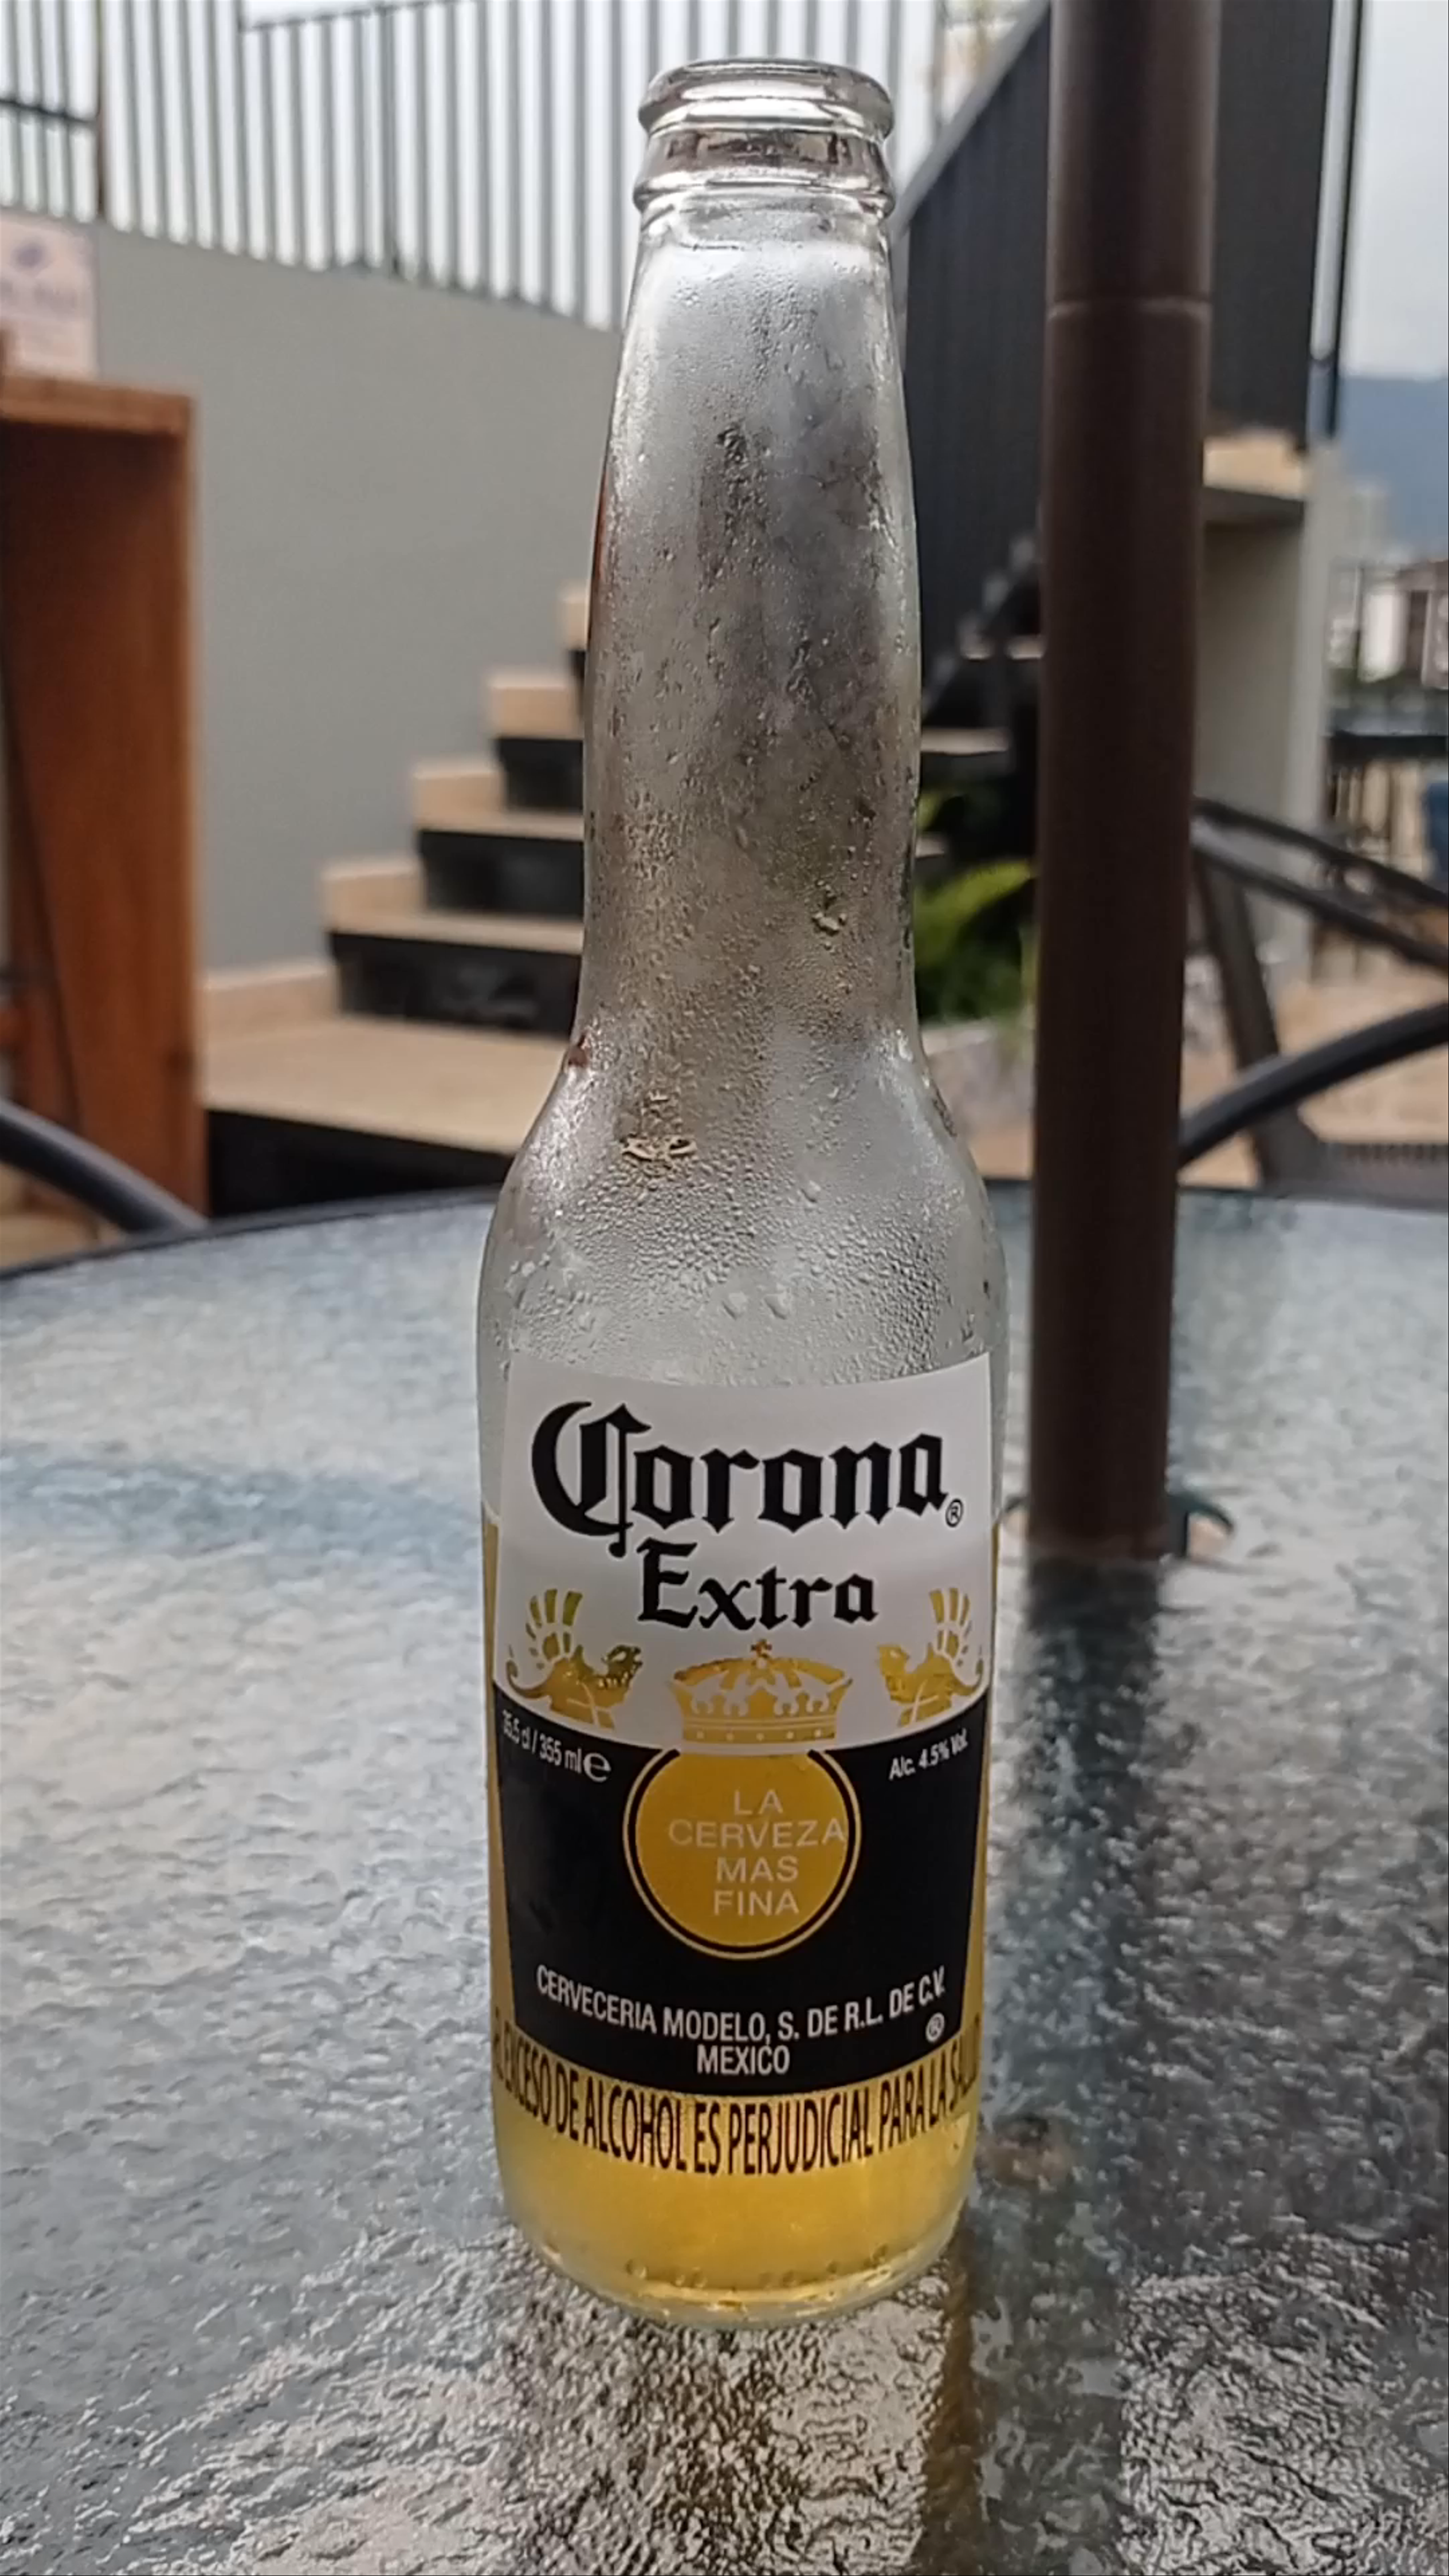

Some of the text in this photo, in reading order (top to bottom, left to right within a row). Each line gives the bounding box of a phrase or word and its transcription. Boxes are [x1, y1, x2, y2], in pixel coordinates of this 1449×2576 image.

[531, 1401, 949, 1557] Corona
[636, 1537, 879, 1630] Extra
[539, 1733, 561, 1766] 355
[888, 1755, 916, 1781] Alc.
[734, 1789, 783, 1816] LA
[668, 1818, 846, 1849] CERVEZA
[717, 1855, 799, 1883] MAS
[714, 1888, 800, 1916] FINA
[536, 1964, 657, 2034] CERVECERIA
[663, 2006, 771, 2047] MODELO,
[777, 2010, 800, 2041] S.
[807, 2004, 838, 2038] DE
[843, 1996, 883, 2032] R.L.
[889, 1981, 915, 2019] DE
[697, 2044, 790, 2076] MEXICO
[556, 2068, 578, 2141] DE
[584, 2075, 687, 2172] ALCOHOL
[694, 2101, 720, 2176] ES
[729, 2086, 874, 2176] PERJUDICIAL
[879, 2064, 927, 2153] PARA
[929, 2050, 946, 2128] LA
